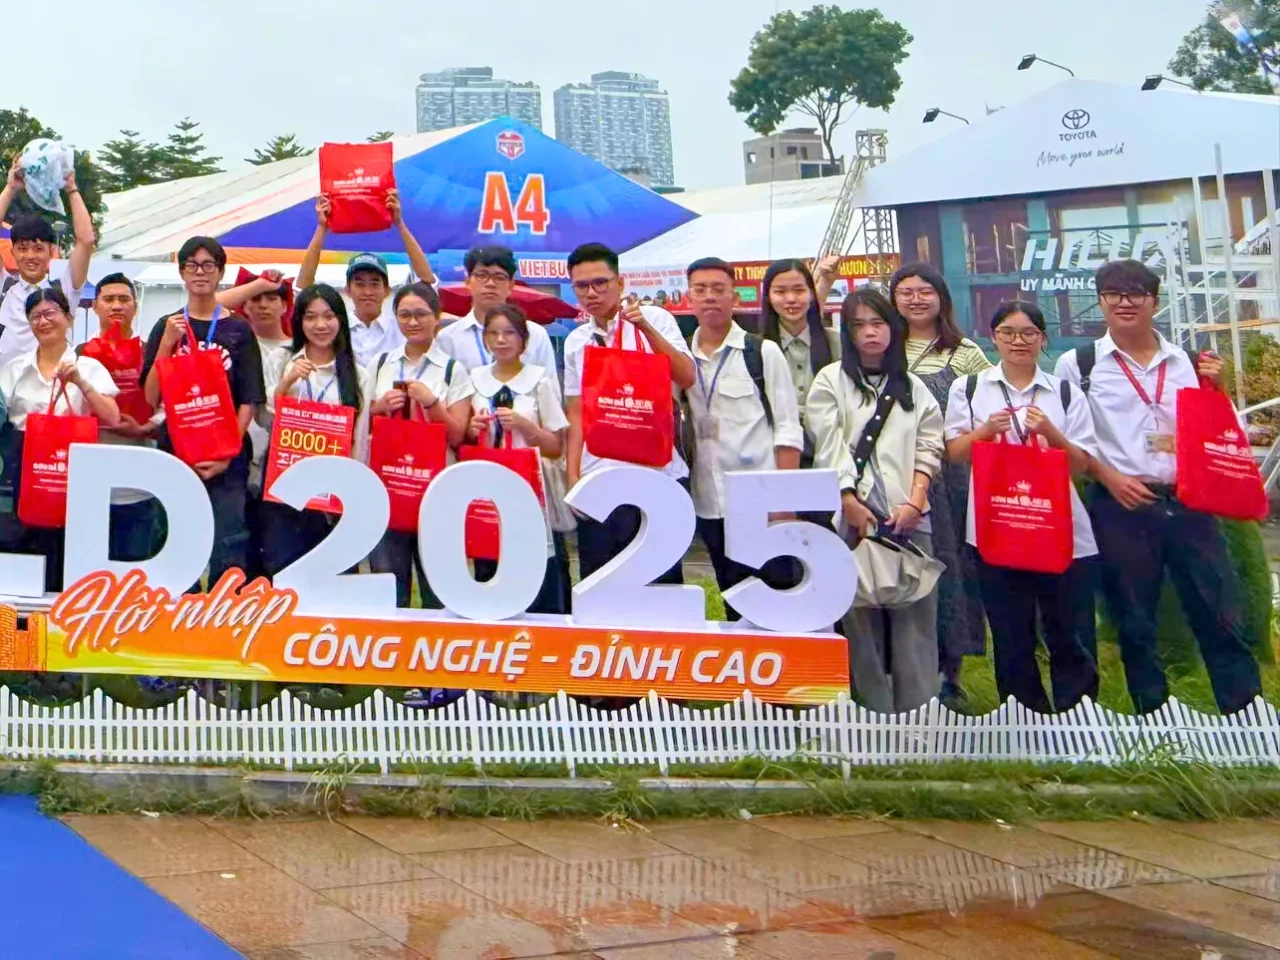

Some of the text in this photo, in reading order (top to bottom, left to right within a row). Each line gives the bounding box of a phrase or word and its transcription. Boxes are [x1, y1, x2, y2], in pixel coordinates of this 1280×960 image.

[1058, 130, 1097, 142] TOYOTA
[478, 171, 551, 236] A4
[519, 259, 570, 279] VIETBU
[1042, 273, 1084, 291] MÃNH
[268, 454, 858, 633] 2025
[172, 572, 293, 659] nhập
[282, 623, 402, 670] CÔNG
[408, 632, 533, 682] NGHỆ
[570, 632, 683, 682] ĐỈNH
[690, 649, 784, 687] CAO
